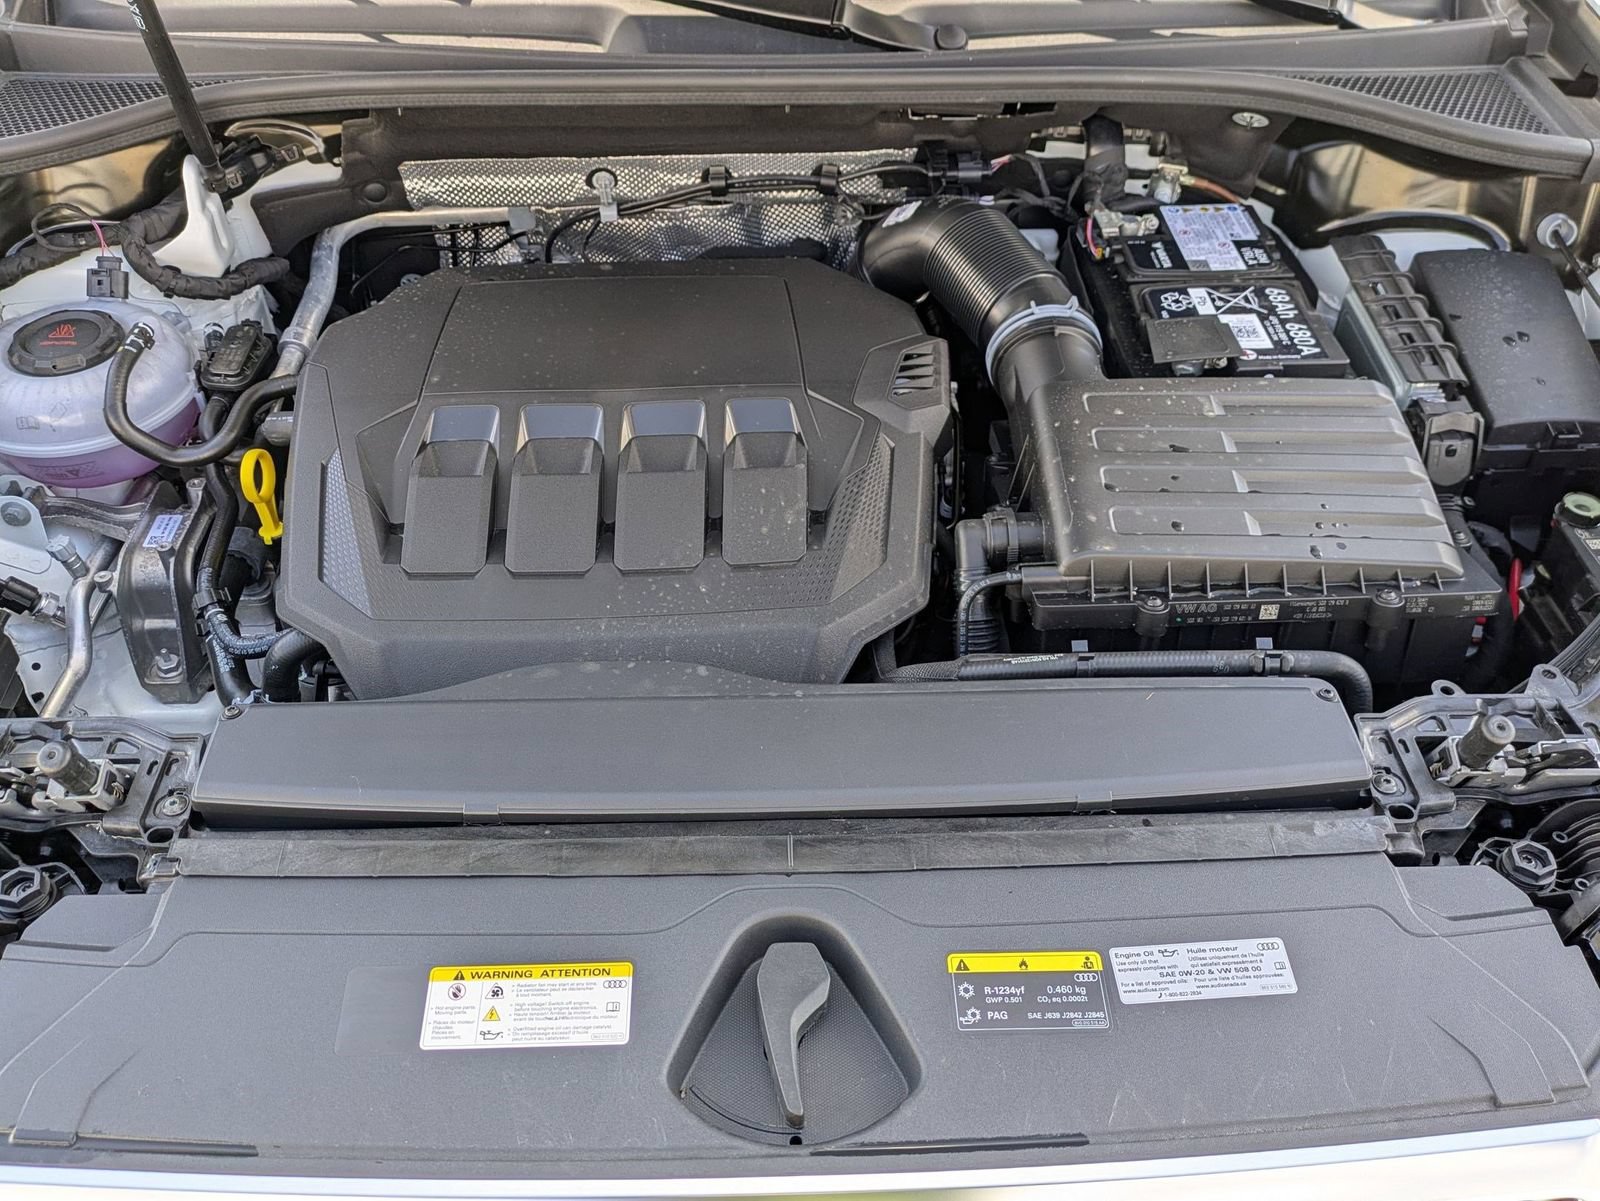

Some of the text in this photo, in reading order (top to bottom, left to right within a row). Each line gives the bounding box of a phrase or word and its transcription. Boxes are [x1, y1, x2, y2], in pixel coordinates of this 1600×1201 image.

[1264, 287, 1298, 319] 68Ah
[1285, 322, 1321, 356] 680A
[1176, 604, 1197, 613] VW
[1198, 603, 1218, 612] AG
[470, 968, 611, 980] WARNING ATTENTION
[984, 985, 1086, 996] R-1234yf 0.460 kg
[987, 1011, 1008, 1020] PAG
